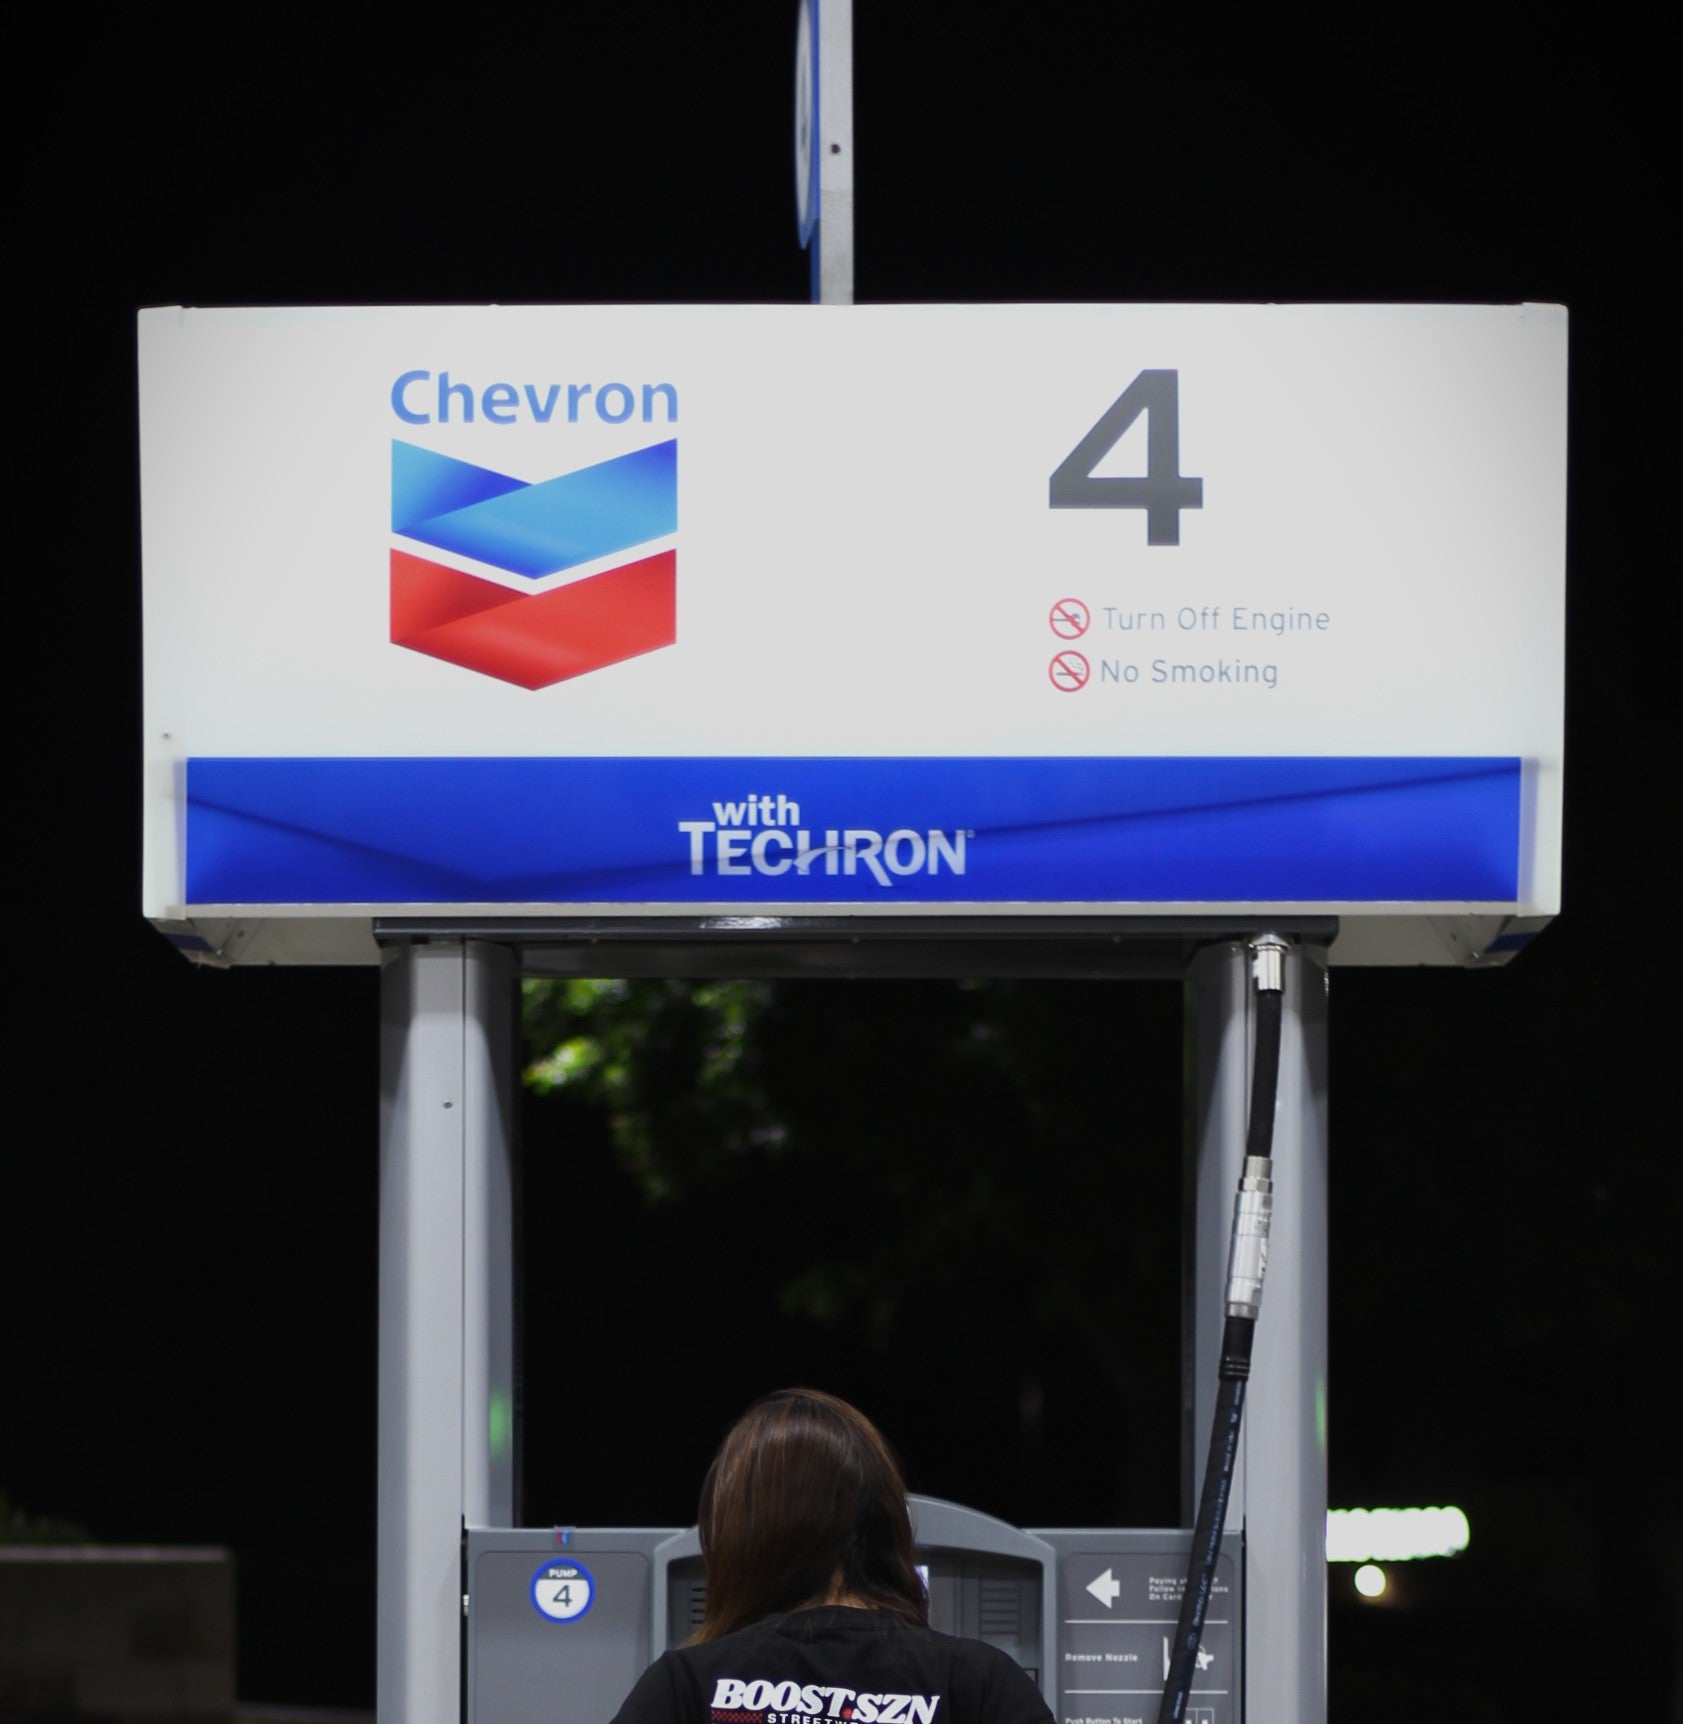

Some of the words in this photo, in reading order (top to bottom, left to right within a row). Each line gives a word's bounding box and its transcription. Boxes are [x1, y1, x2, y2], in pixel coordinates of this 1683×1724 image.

[391, 370, 679, 425] Chevron
[1049, 369, 1203, 546] 4
[1103, 607, 1165, 630] Turn
[1178, 607, 1221, 630] Off
[1233, 607, 1331, 636] Engine
[1100, 659, 1139, 684] No
[1151, 659, 1278, 688] Smoking
[713, 794, 799, 826] with
[549, 1568, 578, 1578] PUMP
[553, 1584, 572, 1607] 4
[1065, 1653, 1102, 1661] Remove
[1105, 1653, 1138, 1661] Nozzle
[1065, 1717, 1084, 1724] Push
[1086, 1717, 1111, 1724] Button
[1113, 1717, 1121, 1724] To
[1123, 1717, 1142, 1724] Start
